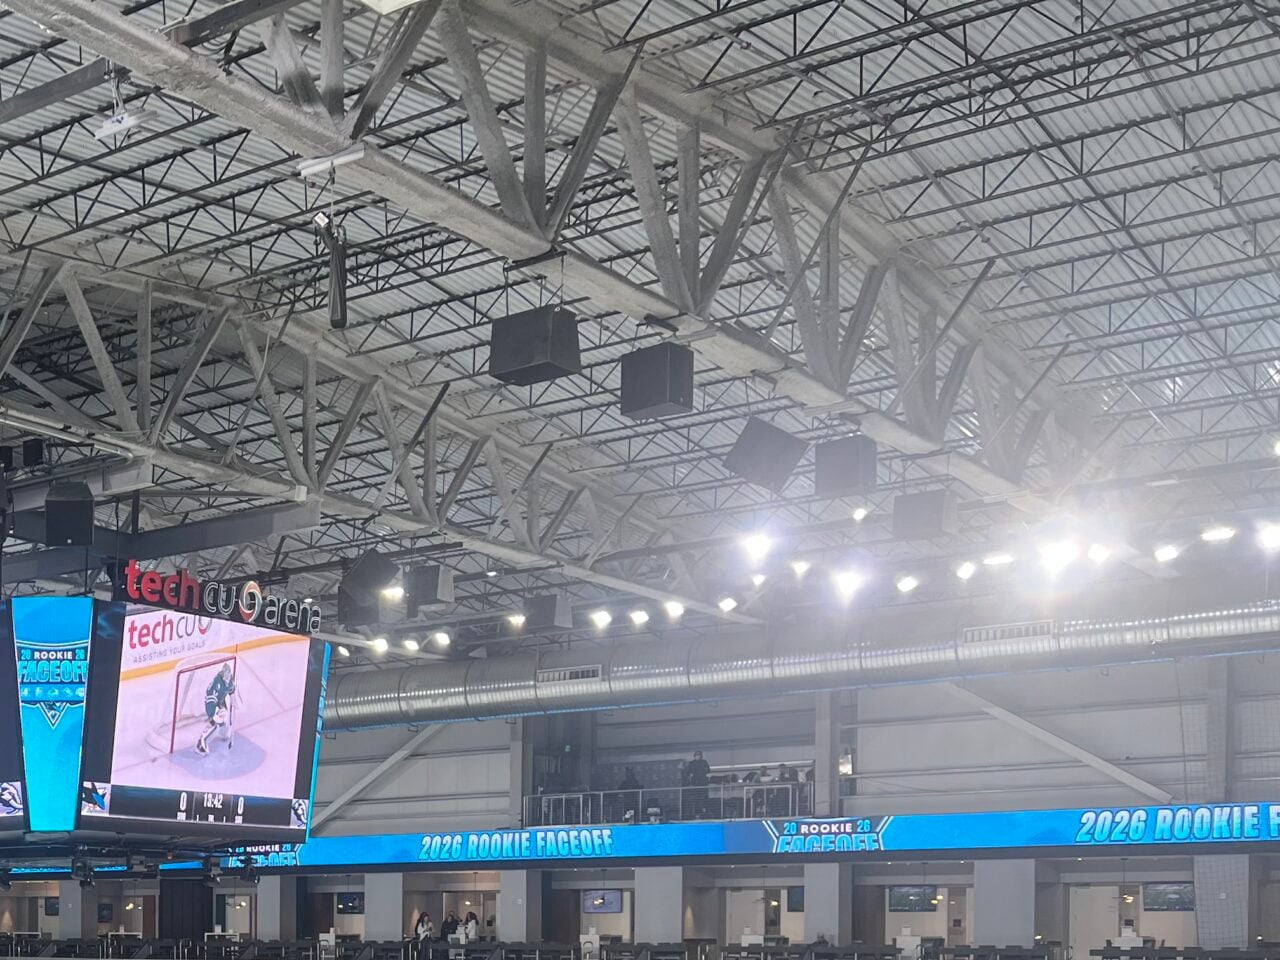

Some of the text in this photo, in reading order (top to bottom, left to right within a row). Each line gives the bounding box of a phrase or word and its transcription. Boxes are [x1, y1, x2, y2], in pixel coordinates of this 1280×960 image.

[265, 595, 321, 634] arena
[34, 651, 73, 660] ROOKIE
[203, 792, 223, 809] 13:42
[783, 820, 870, 835] 20 ROOKIE 26
[1074, 809, 1149, 843] 2026
[1153, 804, 1261, 841] ROOKIE
[418, 828, 614, 861] 2026 ROOKIE FACEOFF
[777, 833, 880, 853] FACEOFF
